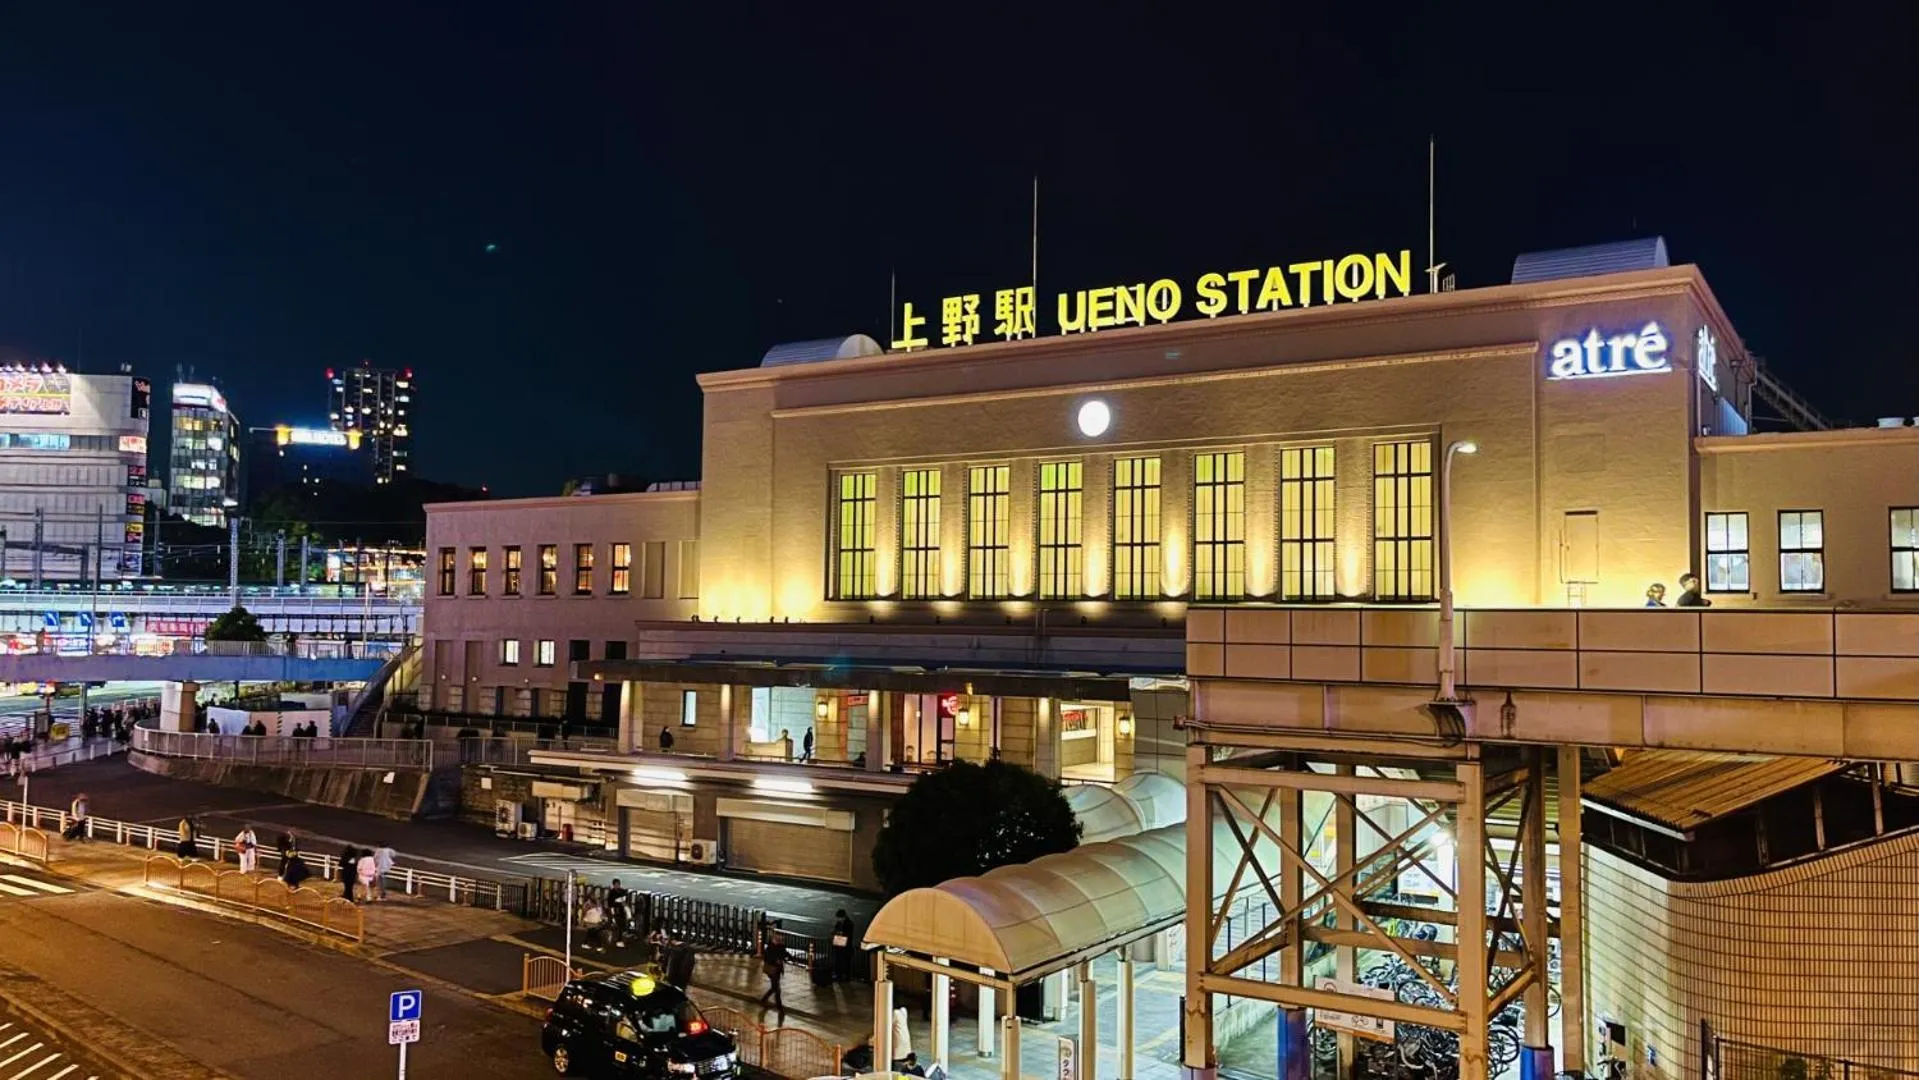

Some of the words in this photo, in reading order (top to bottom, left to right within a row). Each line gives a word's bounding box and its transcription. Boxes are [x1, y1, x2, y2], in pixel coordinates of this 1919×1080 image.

[891, 287, 1035, 348] 上野駅
[1057, 279, 1181, 330] UENO
[1196, 250, 1411, 313] STATION
[1551, 321, 1667, 376] atré
[398, 994, 416, 1018] P
